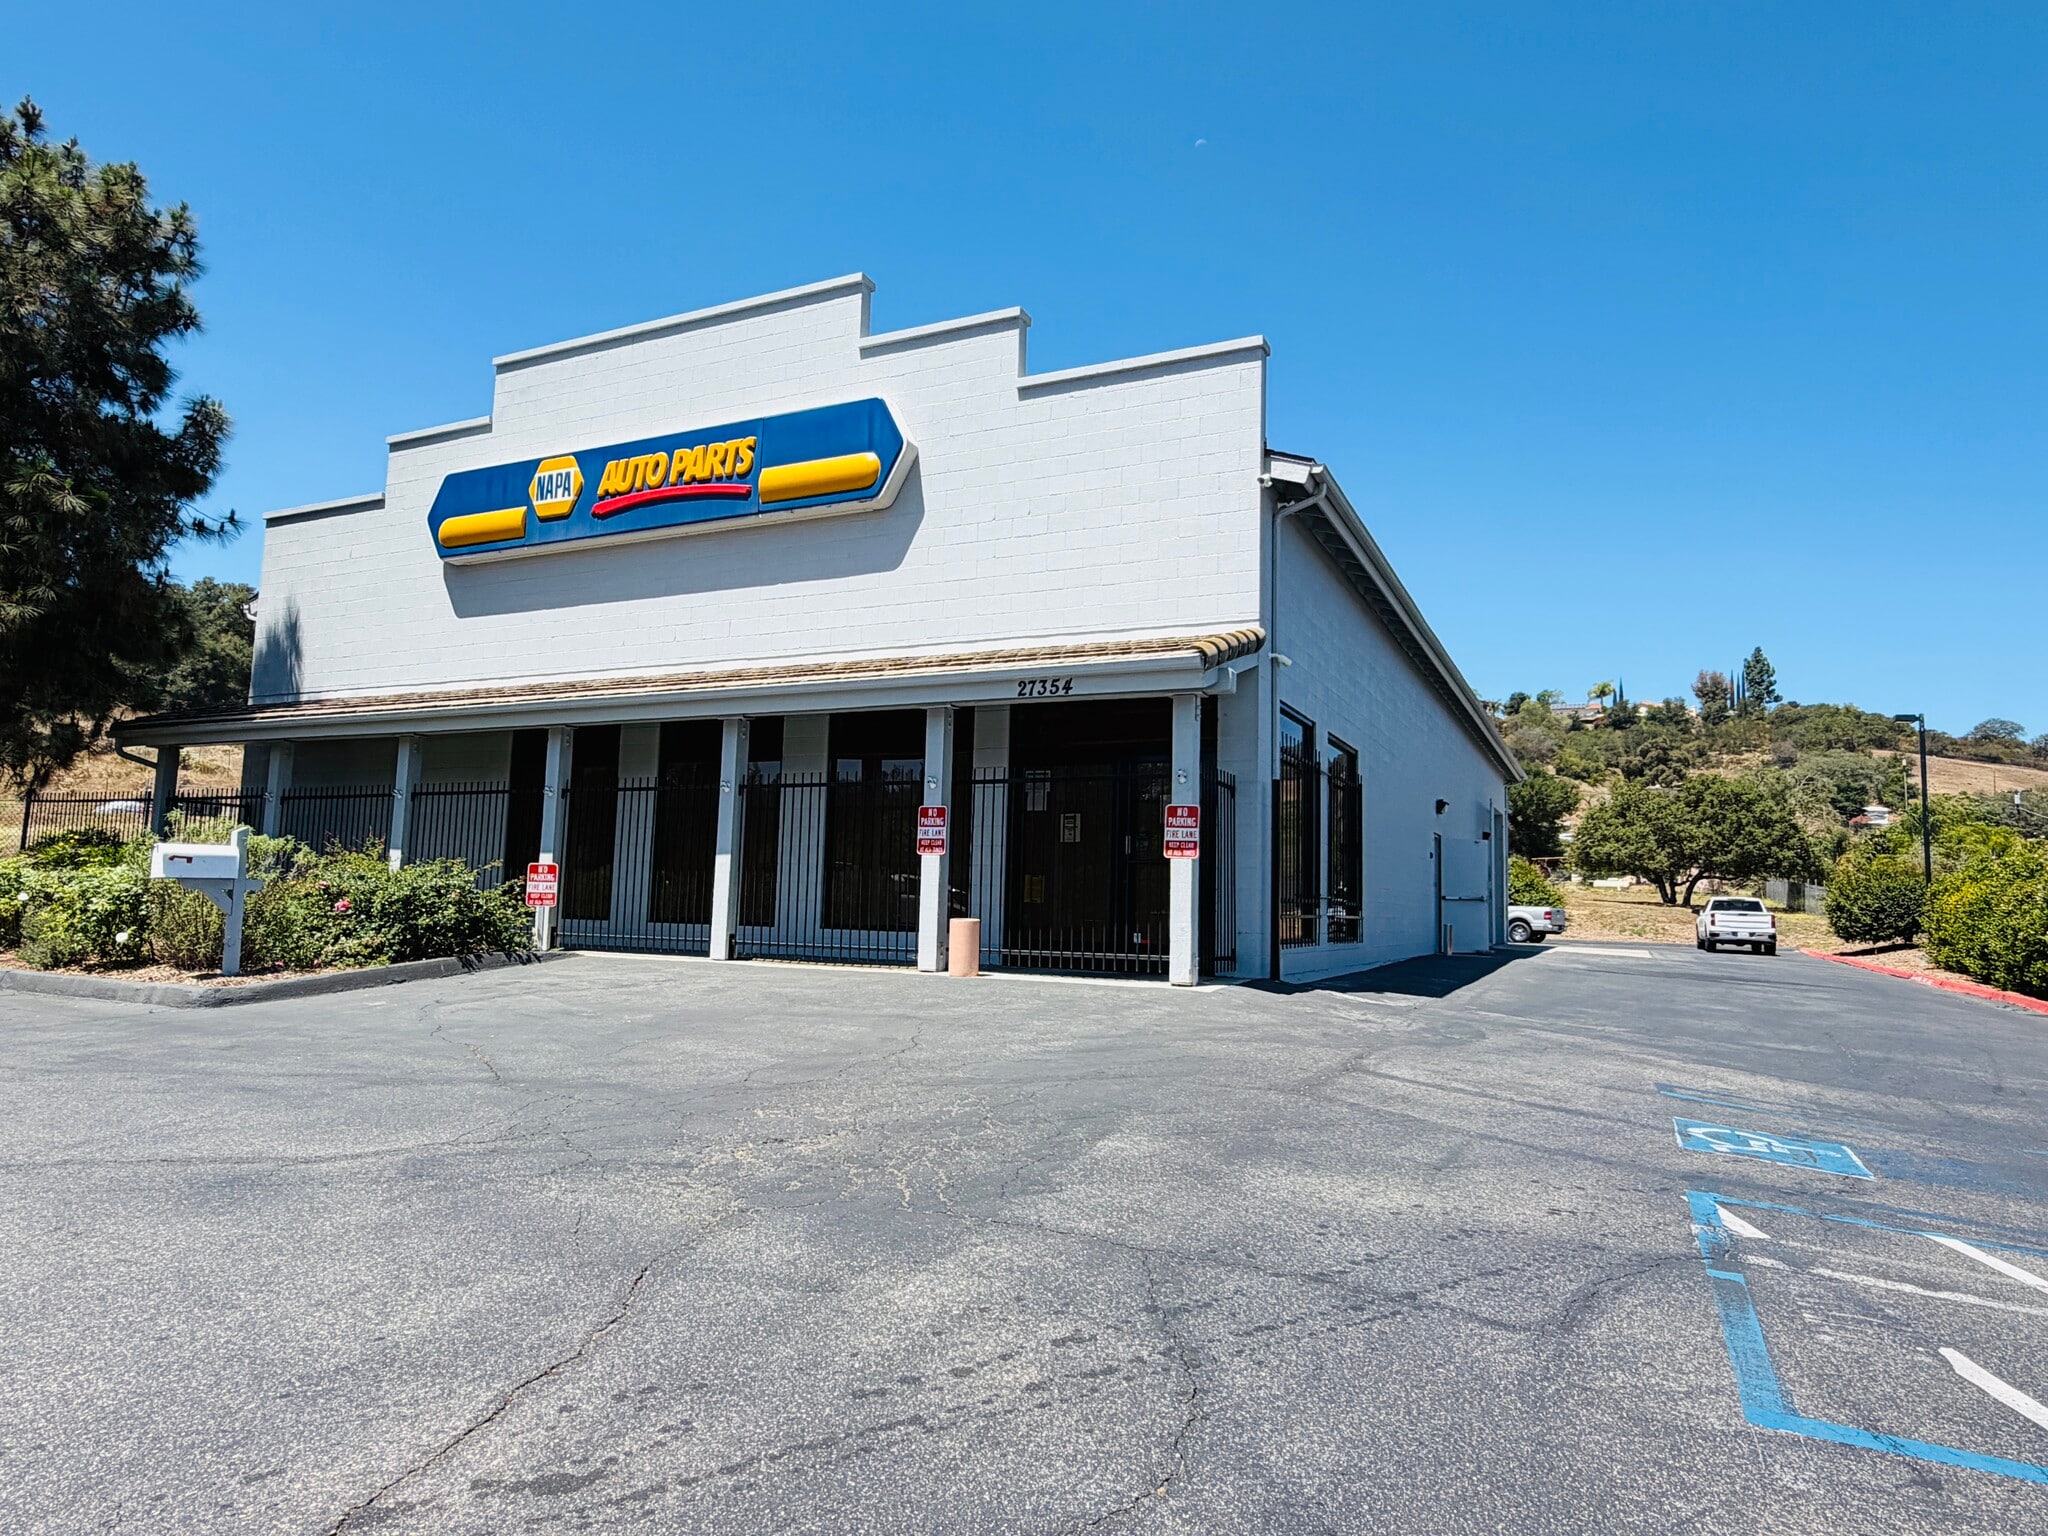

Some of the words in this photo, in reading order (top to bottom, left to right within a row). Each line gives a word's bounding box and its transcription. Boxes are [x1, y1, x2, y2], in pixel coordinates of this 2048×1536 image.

[536, 471, 571, 502] NAPA
[597, 452, 668, 496] AUTO
[669, 436, 757, 484] PARTS
[1018, 678, 1073, 696] 27354
[928, 808, 938, 817] NO
[1177, 807, 1188, 816] NO
[921, 818, 944, 826] PARKING
[1168, 817, 1196, 826] PARKING
[1166, 830, 1179, 838] FIRE
[1182, 830, 1197, 838] LANE
[530, 873, 556, 881] PARKING
